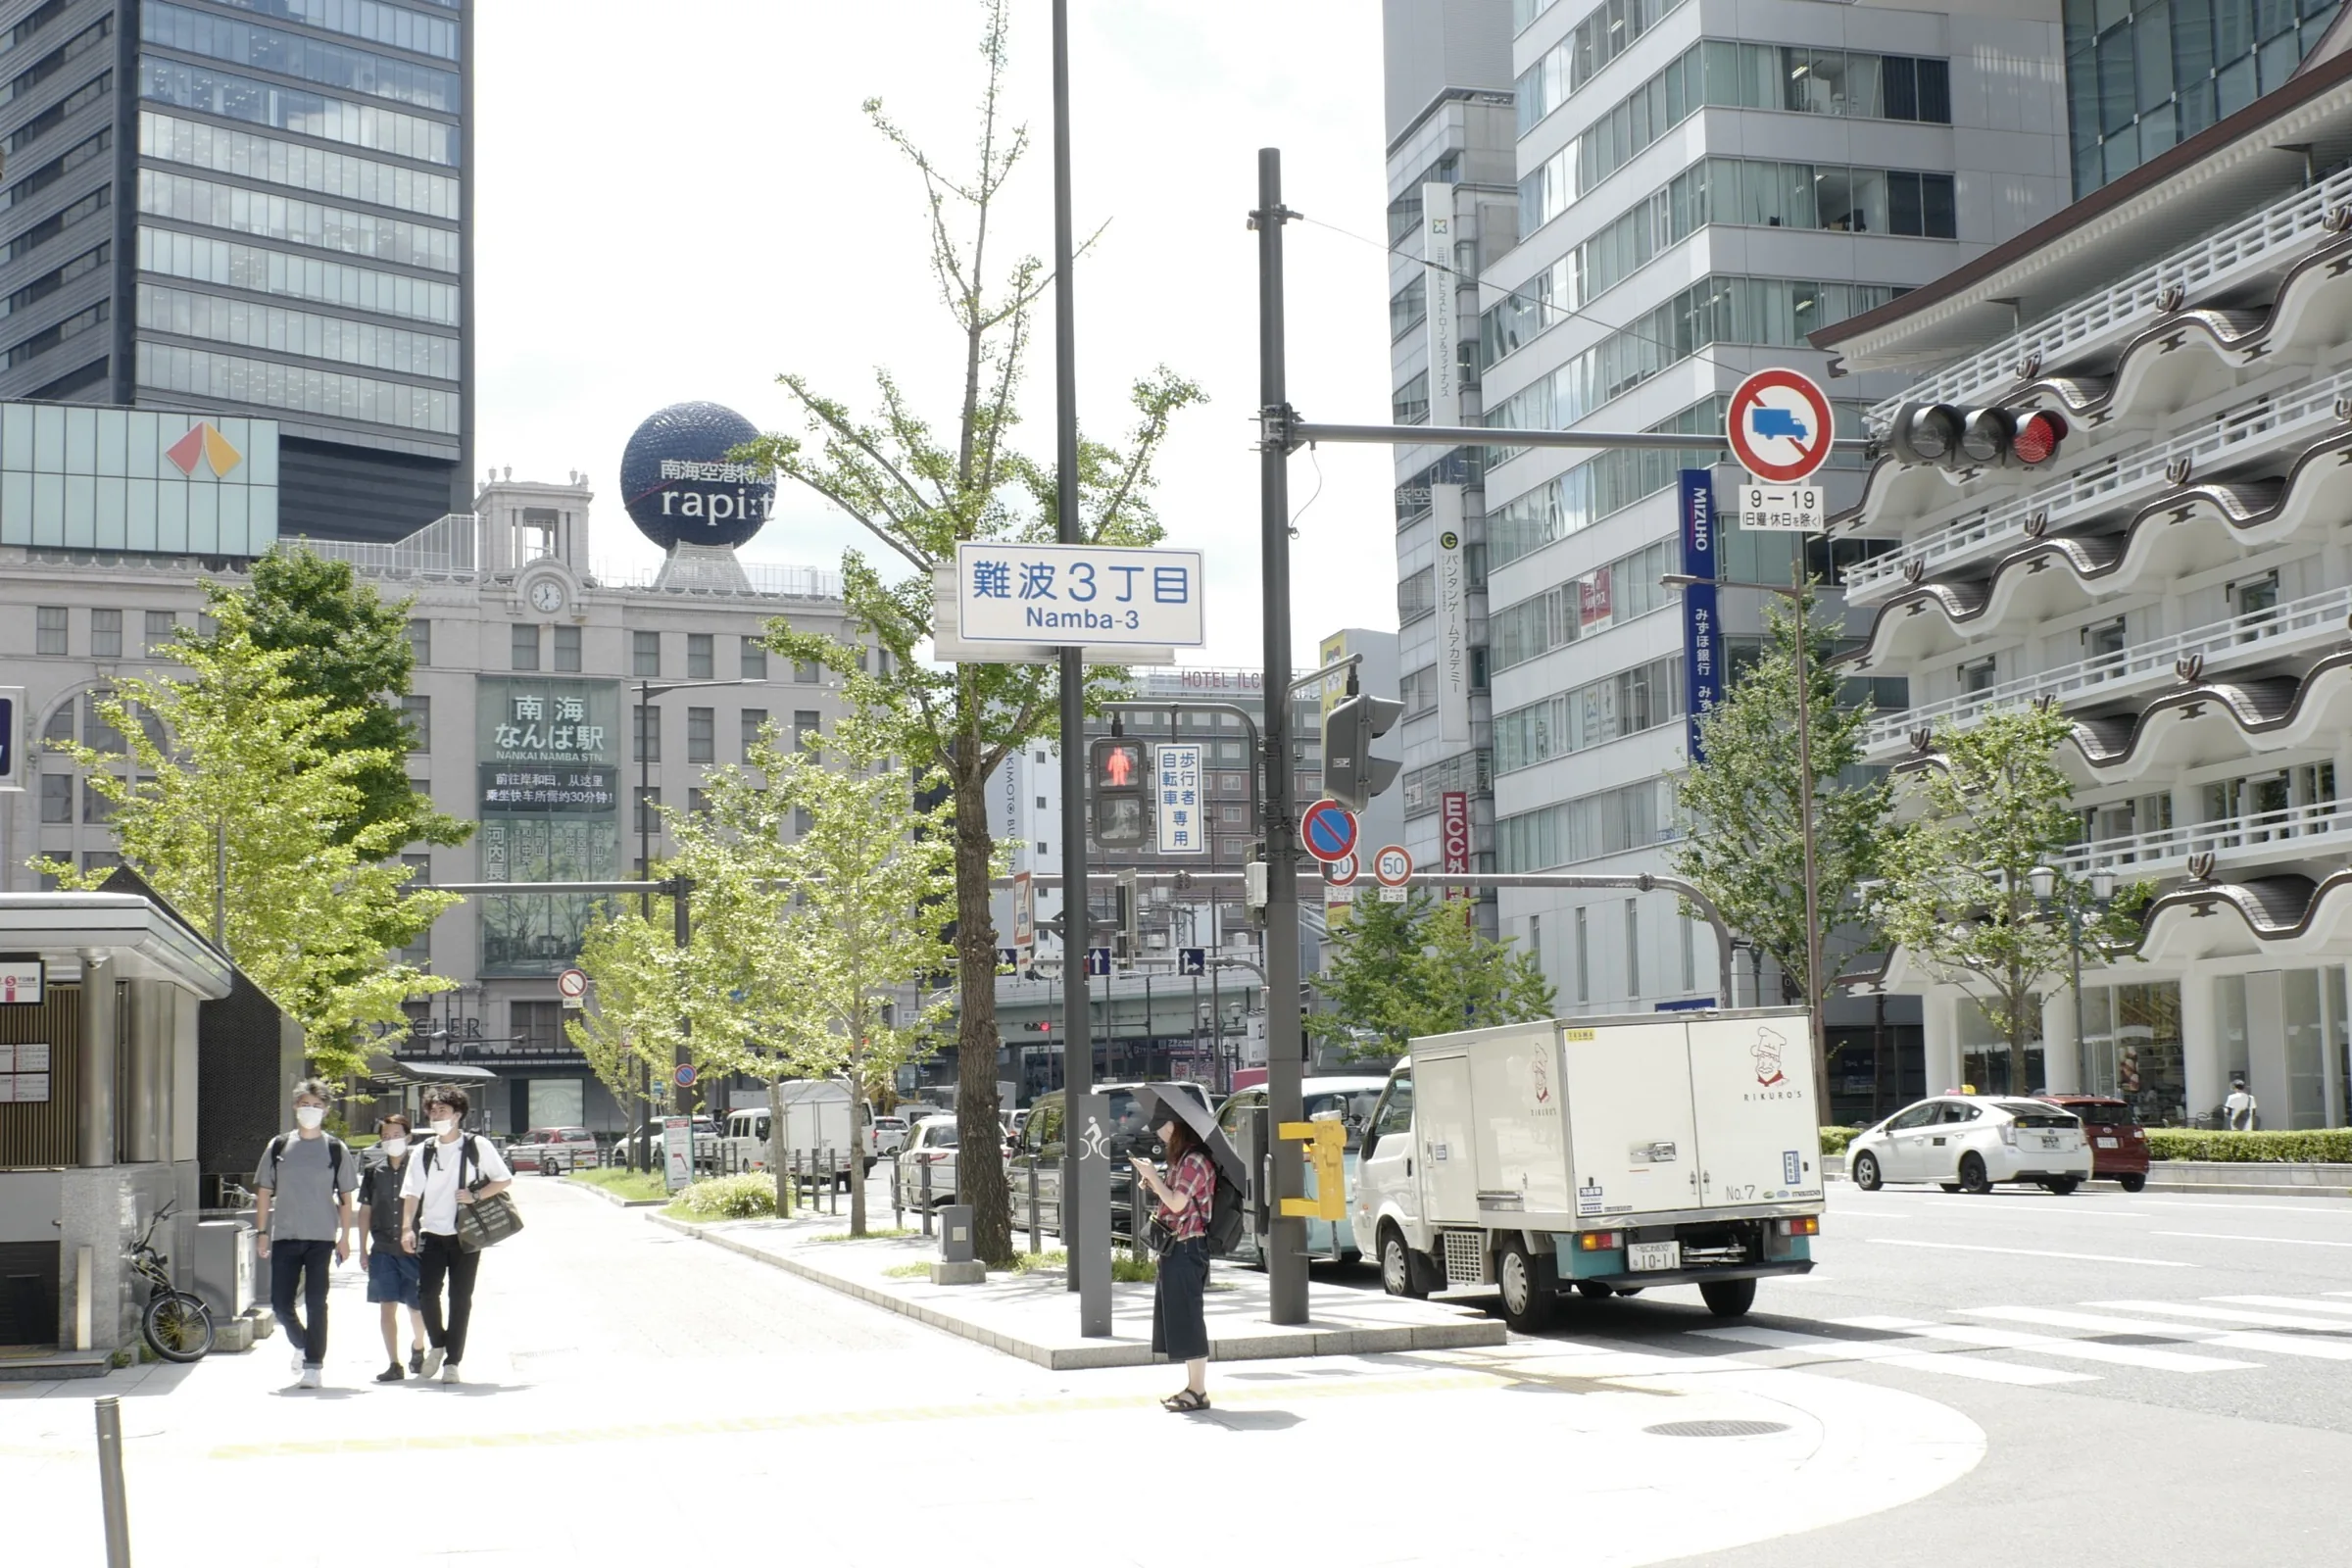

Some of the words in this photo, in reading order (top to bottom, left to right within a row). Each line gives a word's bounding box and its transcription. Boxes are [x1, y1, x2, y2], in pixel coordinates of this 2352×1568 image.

[1693, 487, 1708, 552] MIZUHO
[972, 560, 1188, 604] 難波3丁目
[1026, 606, 1140, 629] Namba-3
[1695, 608, 1711, 676] みずほ銀行
[1181, 670, 1229, 687] HOTEL
[1238, 672, 1264, 688] ILC
[514, 694, 584, 722] 南海
[494, 722, 604, 751] なんば駅
[496, 750, 538, 760] NANKAI
[540, 752, 580, 761] NAMBA
[581, 753, 603, 762] STN
[1161, 752, 1178, 806] 自転車
[1179, 752, 1196, 806] 歩行者
[1172, 809, 1188, 847] 専用
[1383, 857, 1404, 875] 50
[1744, 1091, 1802, 1102] RIKURO'S
[1642, 1252, 1675, 1269] 10-11
